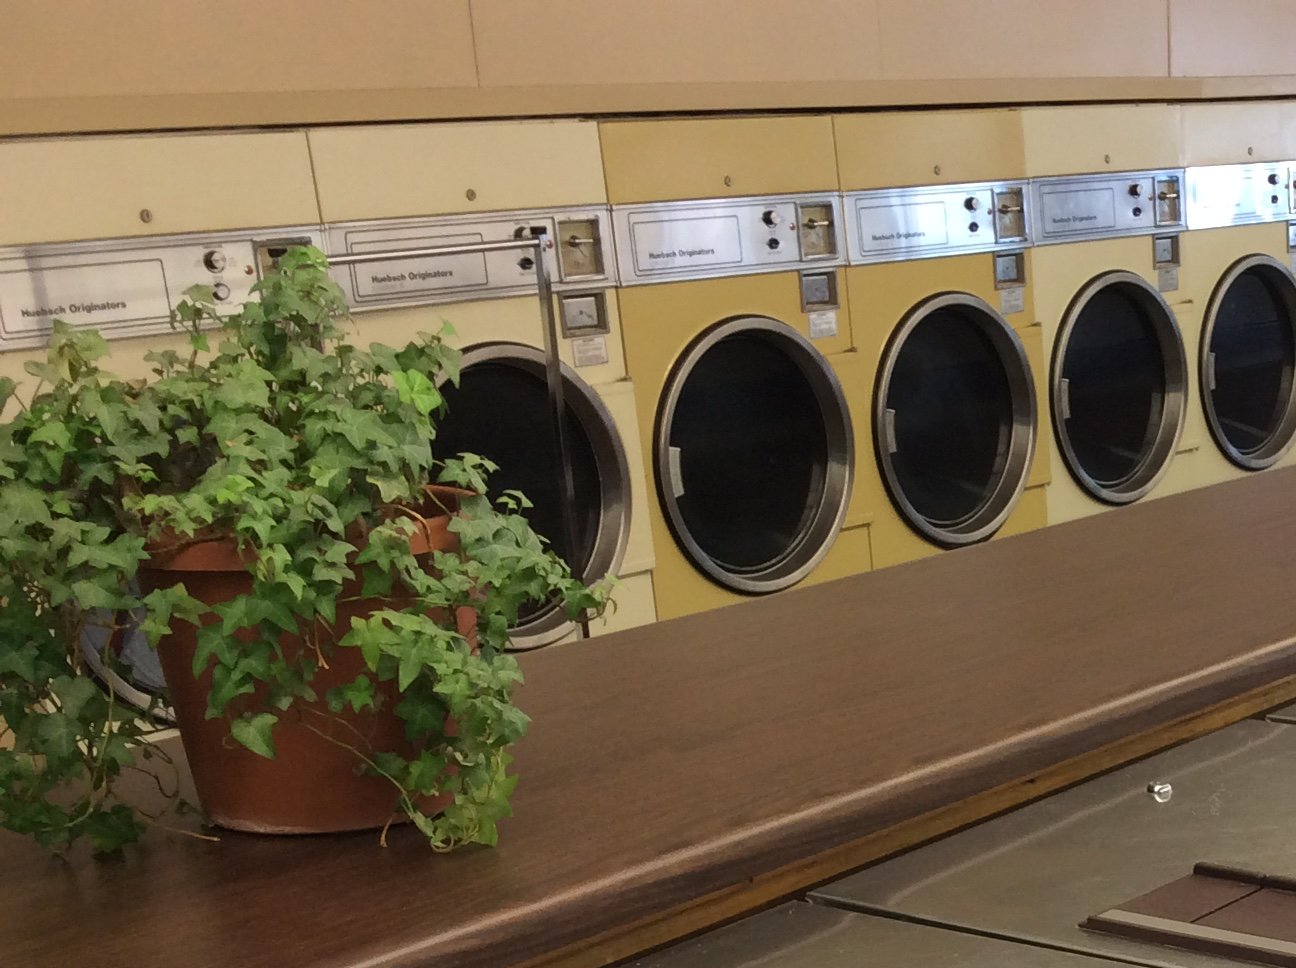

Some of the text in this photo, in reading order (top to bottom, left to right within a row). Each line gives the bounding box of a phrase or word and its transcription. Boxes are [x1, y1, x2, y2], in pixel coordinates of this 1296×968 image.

[371, 270, 453, 284] Huebsch Originators
[21, 300, 127, 318] Huebsch Originators
